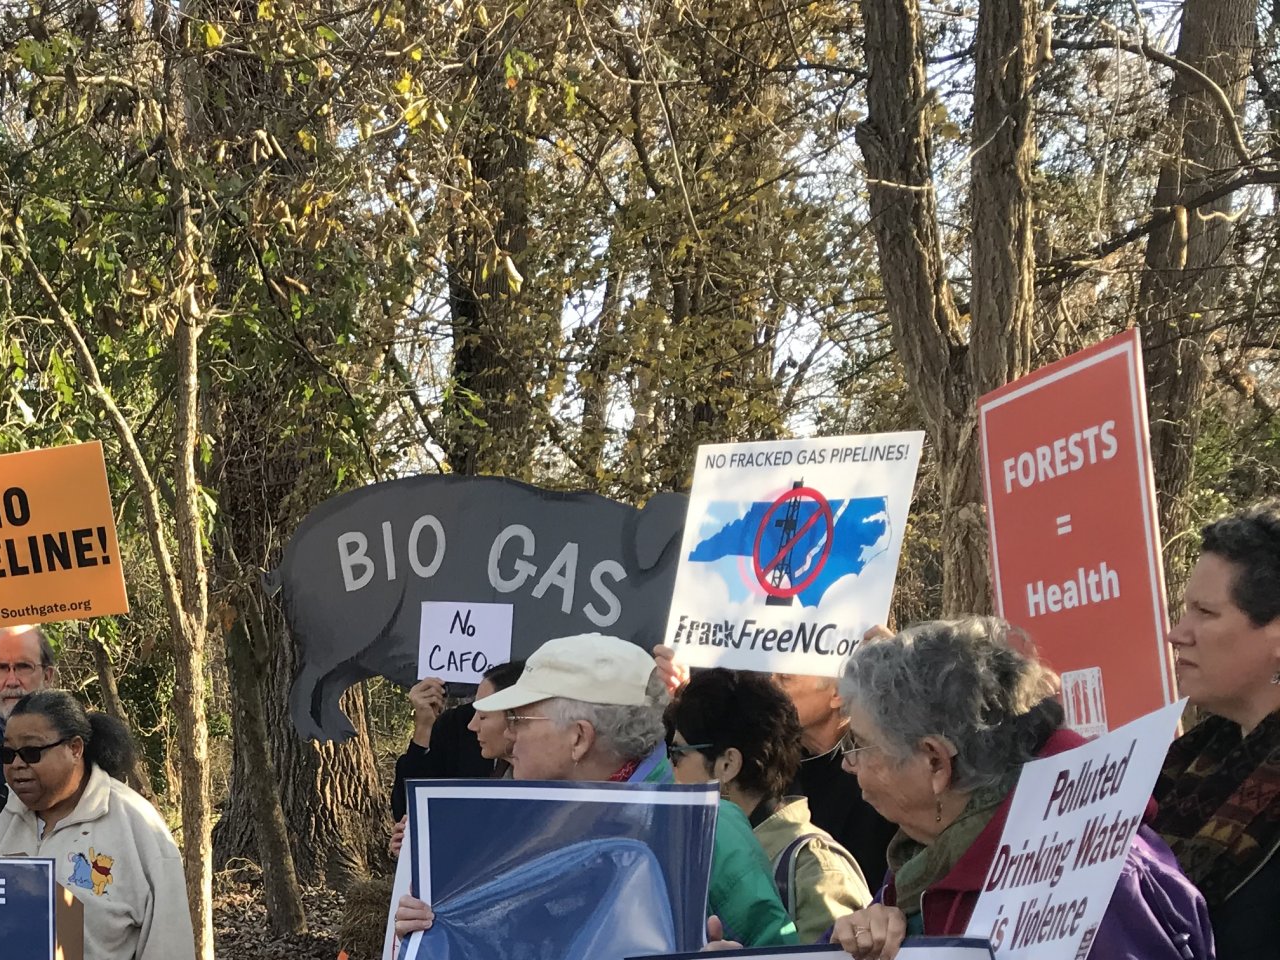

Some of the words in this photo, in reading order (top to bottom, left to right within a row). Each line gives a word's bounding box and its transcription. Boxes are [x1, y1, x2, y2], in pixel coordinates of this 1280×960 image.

[705, 454, 726, 469] NO
[729, 450, 793, 468] FRACKED
[796, 449, 825, 465] GAS
[829, 444, 910, 464] PIPELINES!
[1003, 419, 1118, 494] FORESTS
[1055, 513, 1073, 536] =
[337, 514, 447, 592] BIO
[487, 524, 627, 627] GAS
[1026, 561, 1121, 618] Health
[449, 609, 476, 637] No
[673, 615, 859, 656] FrackFreeNC.or
[1042, 738, 1138, 821] Polluted
[985, 831, 1077, 892] Drinking
[1072, 810, 1141, 871] Water
[990, 904, 1010, 953] is
[1009, 893, 1089, 951] Violence
